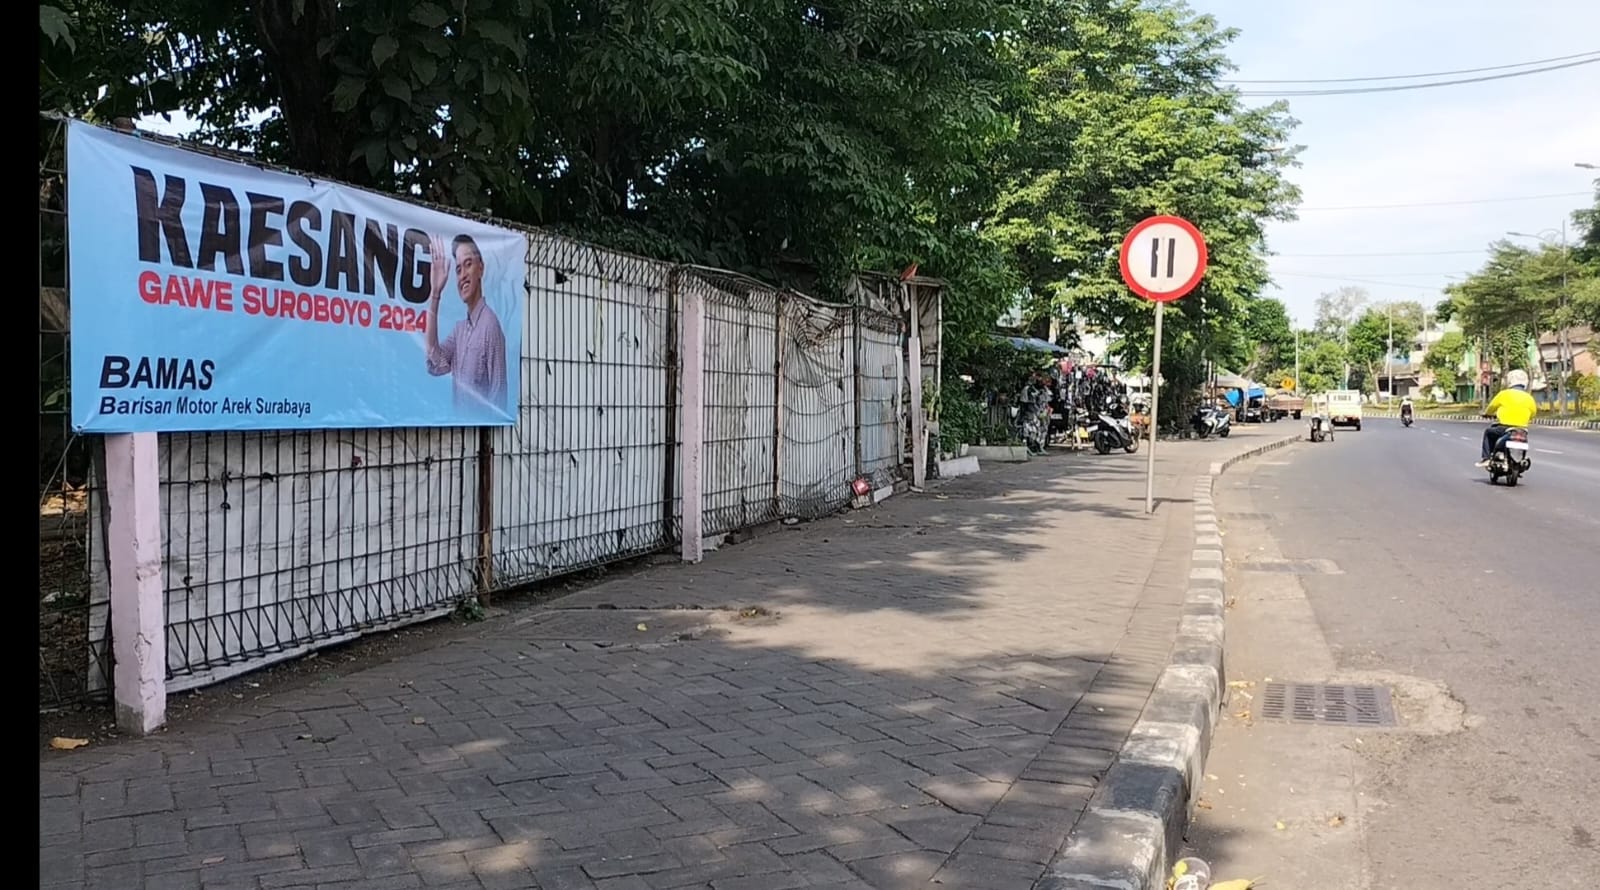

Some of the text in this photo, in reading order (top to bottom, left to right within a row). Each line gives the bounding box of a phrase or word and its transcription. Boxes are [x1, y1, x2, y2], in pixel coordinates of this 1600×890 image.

[130, 165, 432, 304] KAESANG
[138, 270, 428, 333] GAWE SUROBOYO 2024
[99, 355, 215, 391] BAMAS
[99, 396, 311, 418] Barisan Motor Arek Surabaya
